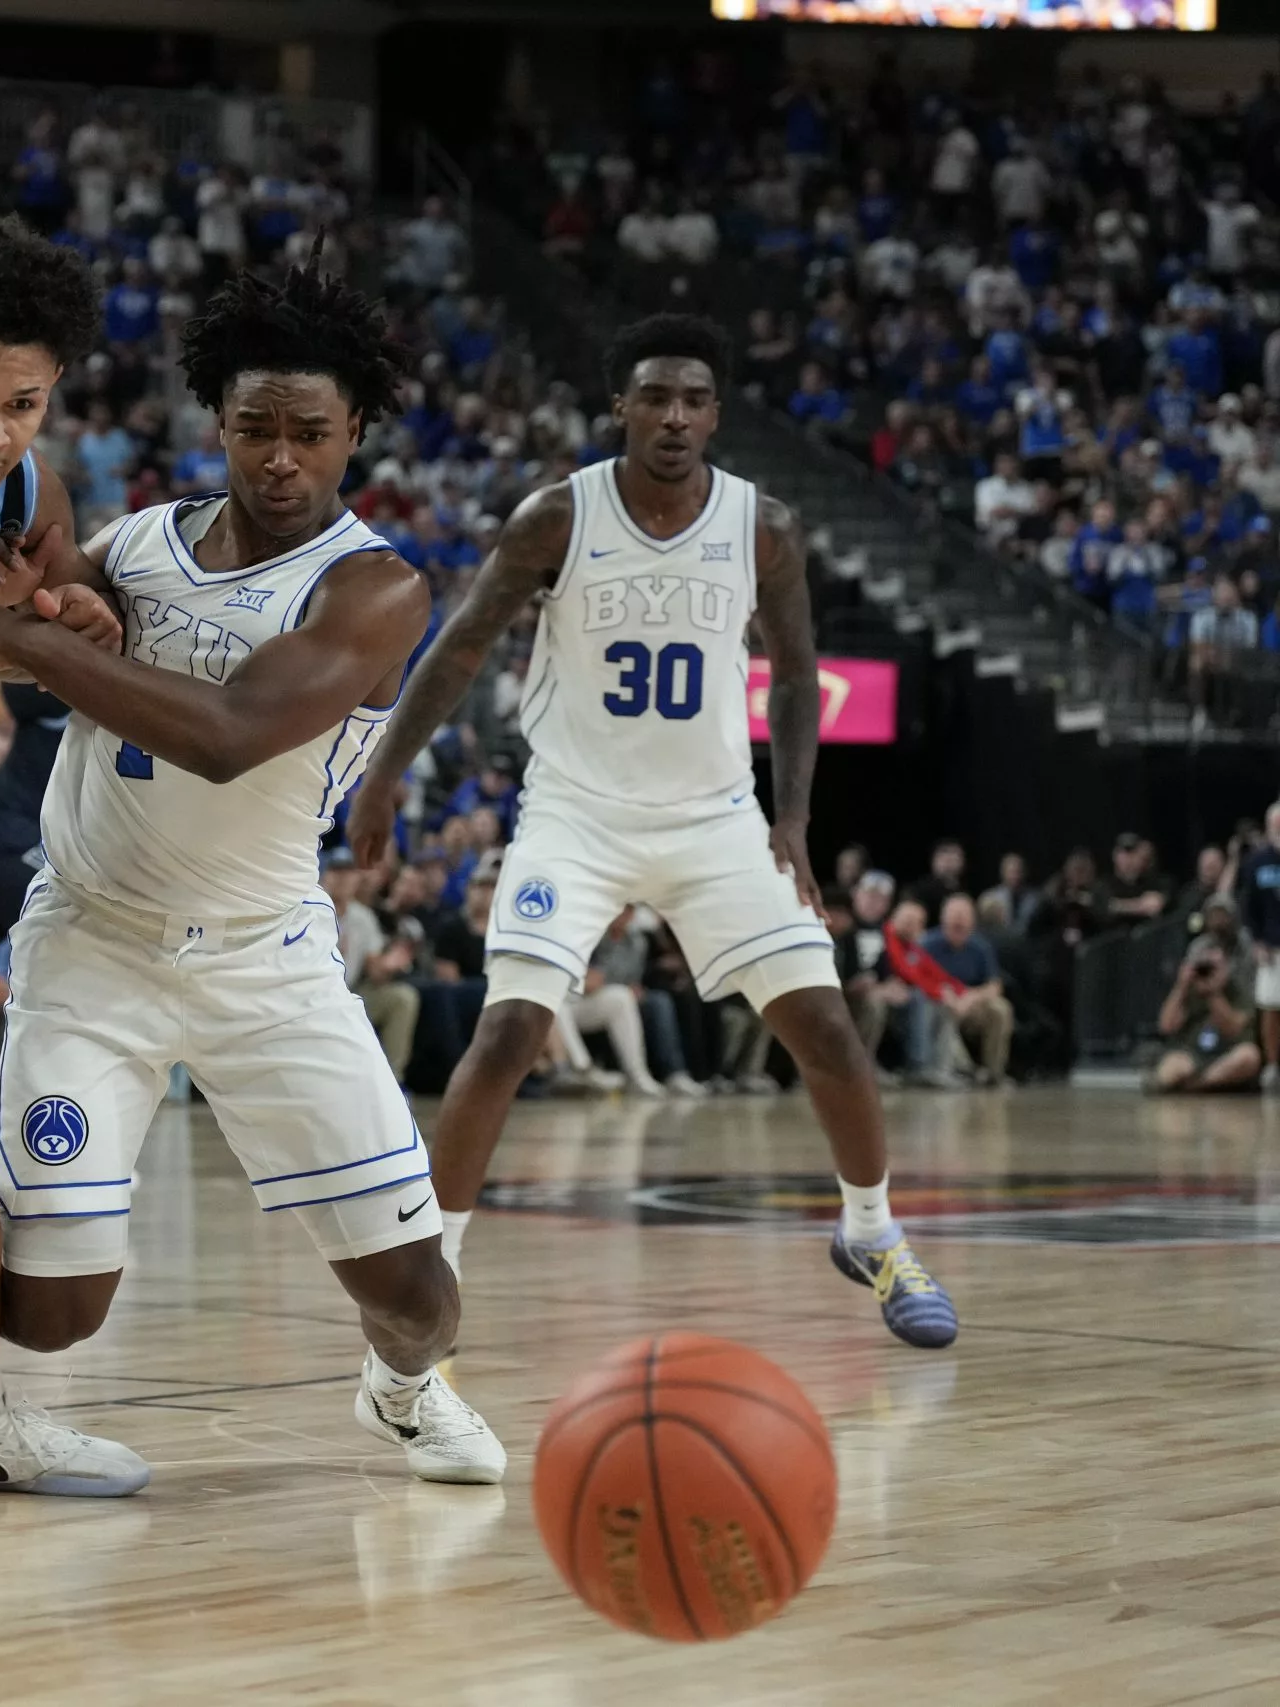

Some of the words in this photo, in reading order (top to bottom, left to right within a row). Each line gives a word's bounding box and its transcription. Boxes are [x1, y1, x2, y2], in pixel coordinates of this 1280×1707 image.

[114, 588, 252, 687] YU
[583, 574, 734, 633] BYU
[603, 641, 704, 720] 30
[42, 1136, 65, 1153] Y
